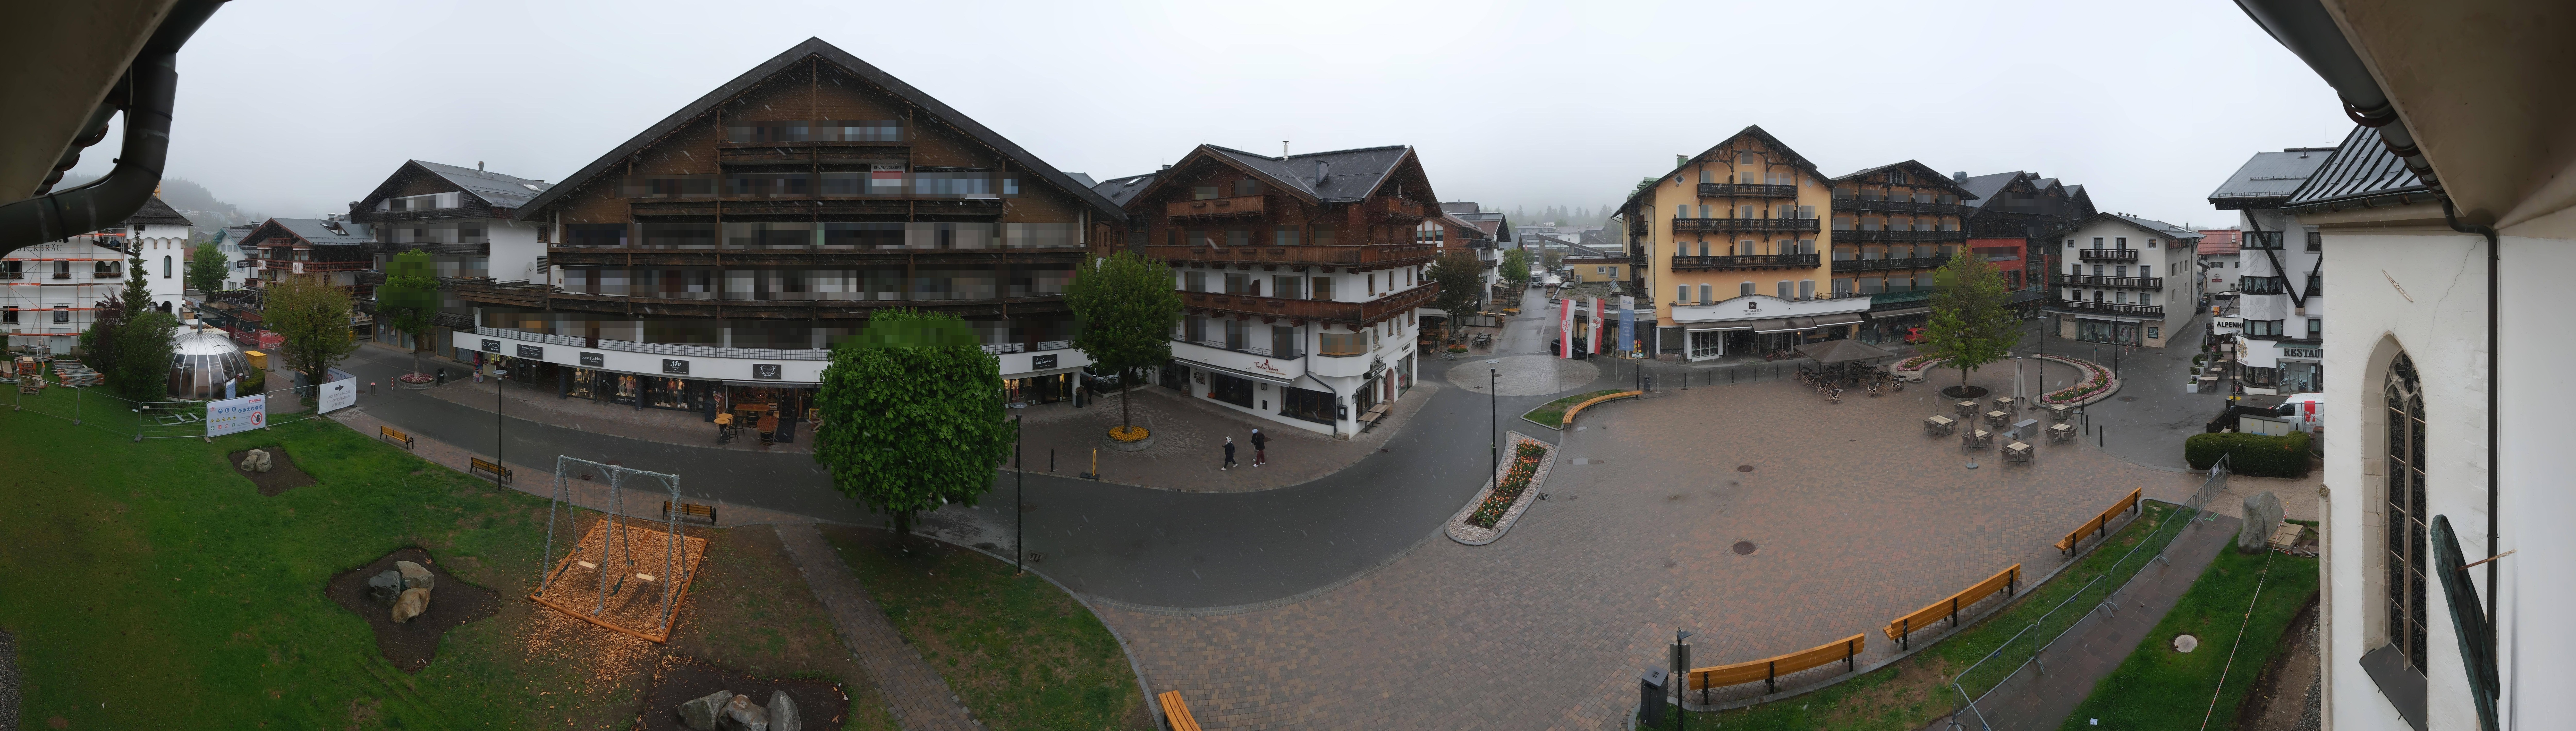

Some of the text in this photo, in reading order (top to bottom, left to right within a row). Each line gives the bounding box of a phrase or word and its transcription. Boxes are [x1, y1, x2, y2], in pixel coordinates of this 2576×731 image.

[1402, 343, 1410, 352] SAILER
[1371, 364, 1385, 377] RESTAURANT
[327, 395, 350, 404] KONGRESSZENTRUM
